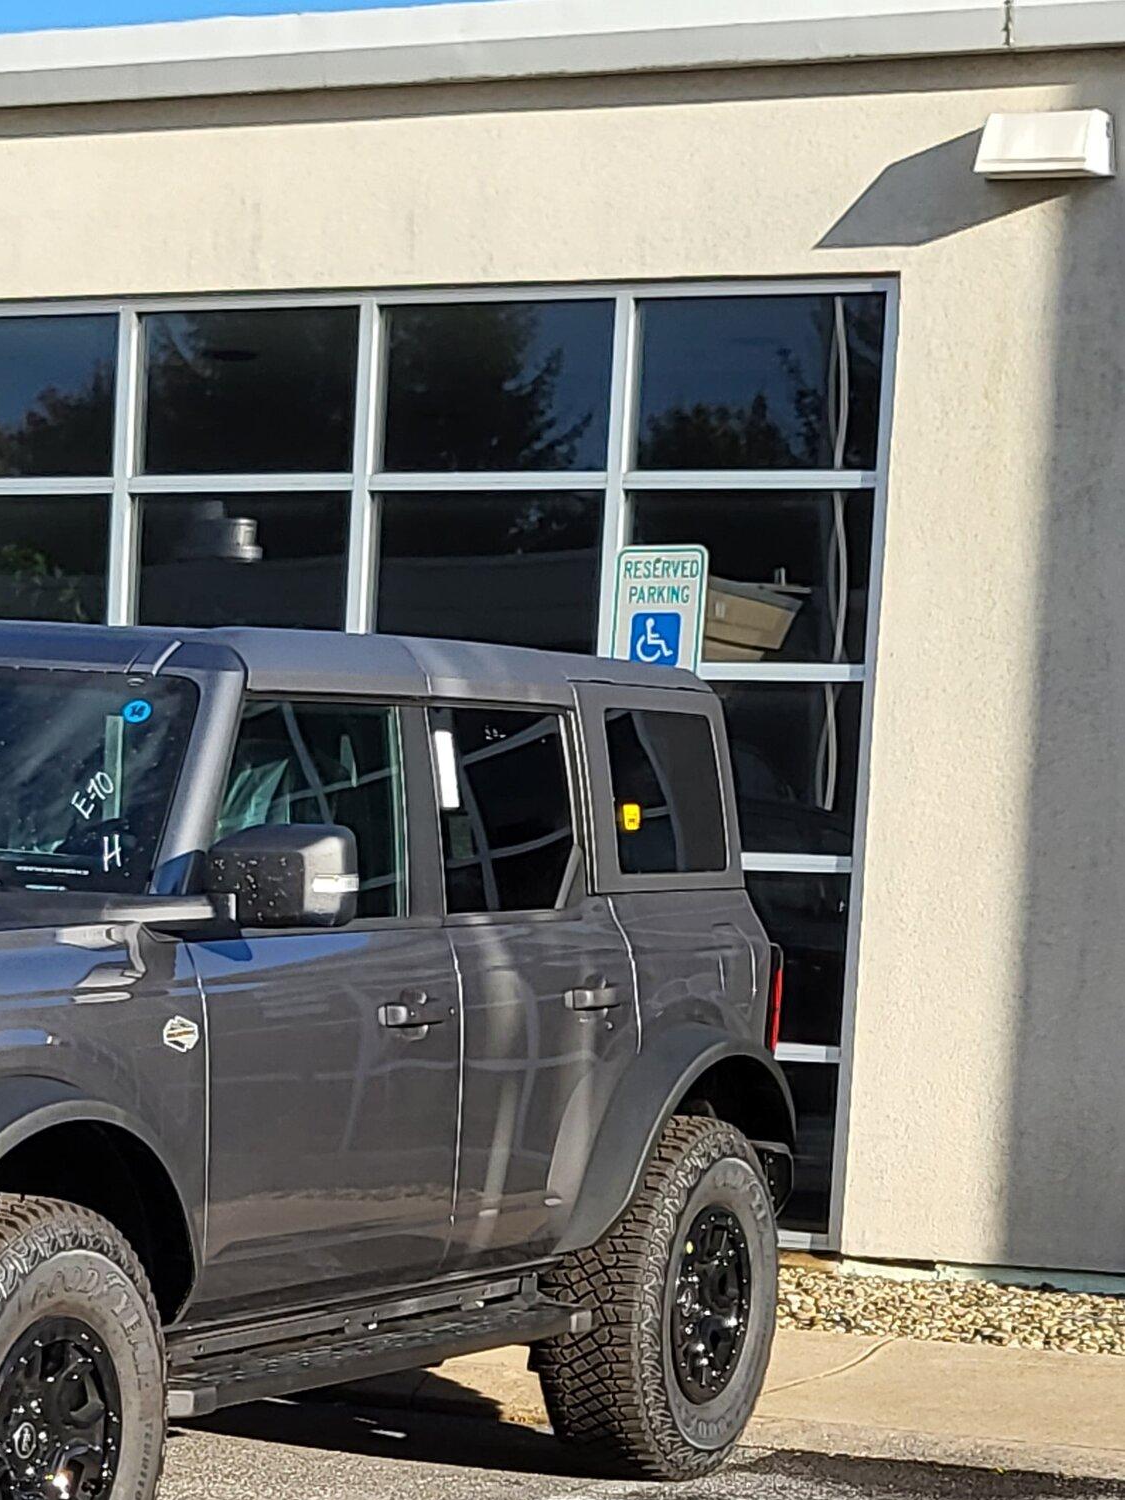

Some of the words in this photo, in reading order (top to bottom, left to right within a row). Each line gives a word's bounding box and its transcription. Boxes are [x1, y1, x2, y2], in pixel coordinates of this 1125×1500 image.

[623, 559, 700, 579] RESERVED
[628, 585, 691, 604] PARKING
[103, 833, 122, 872] H
